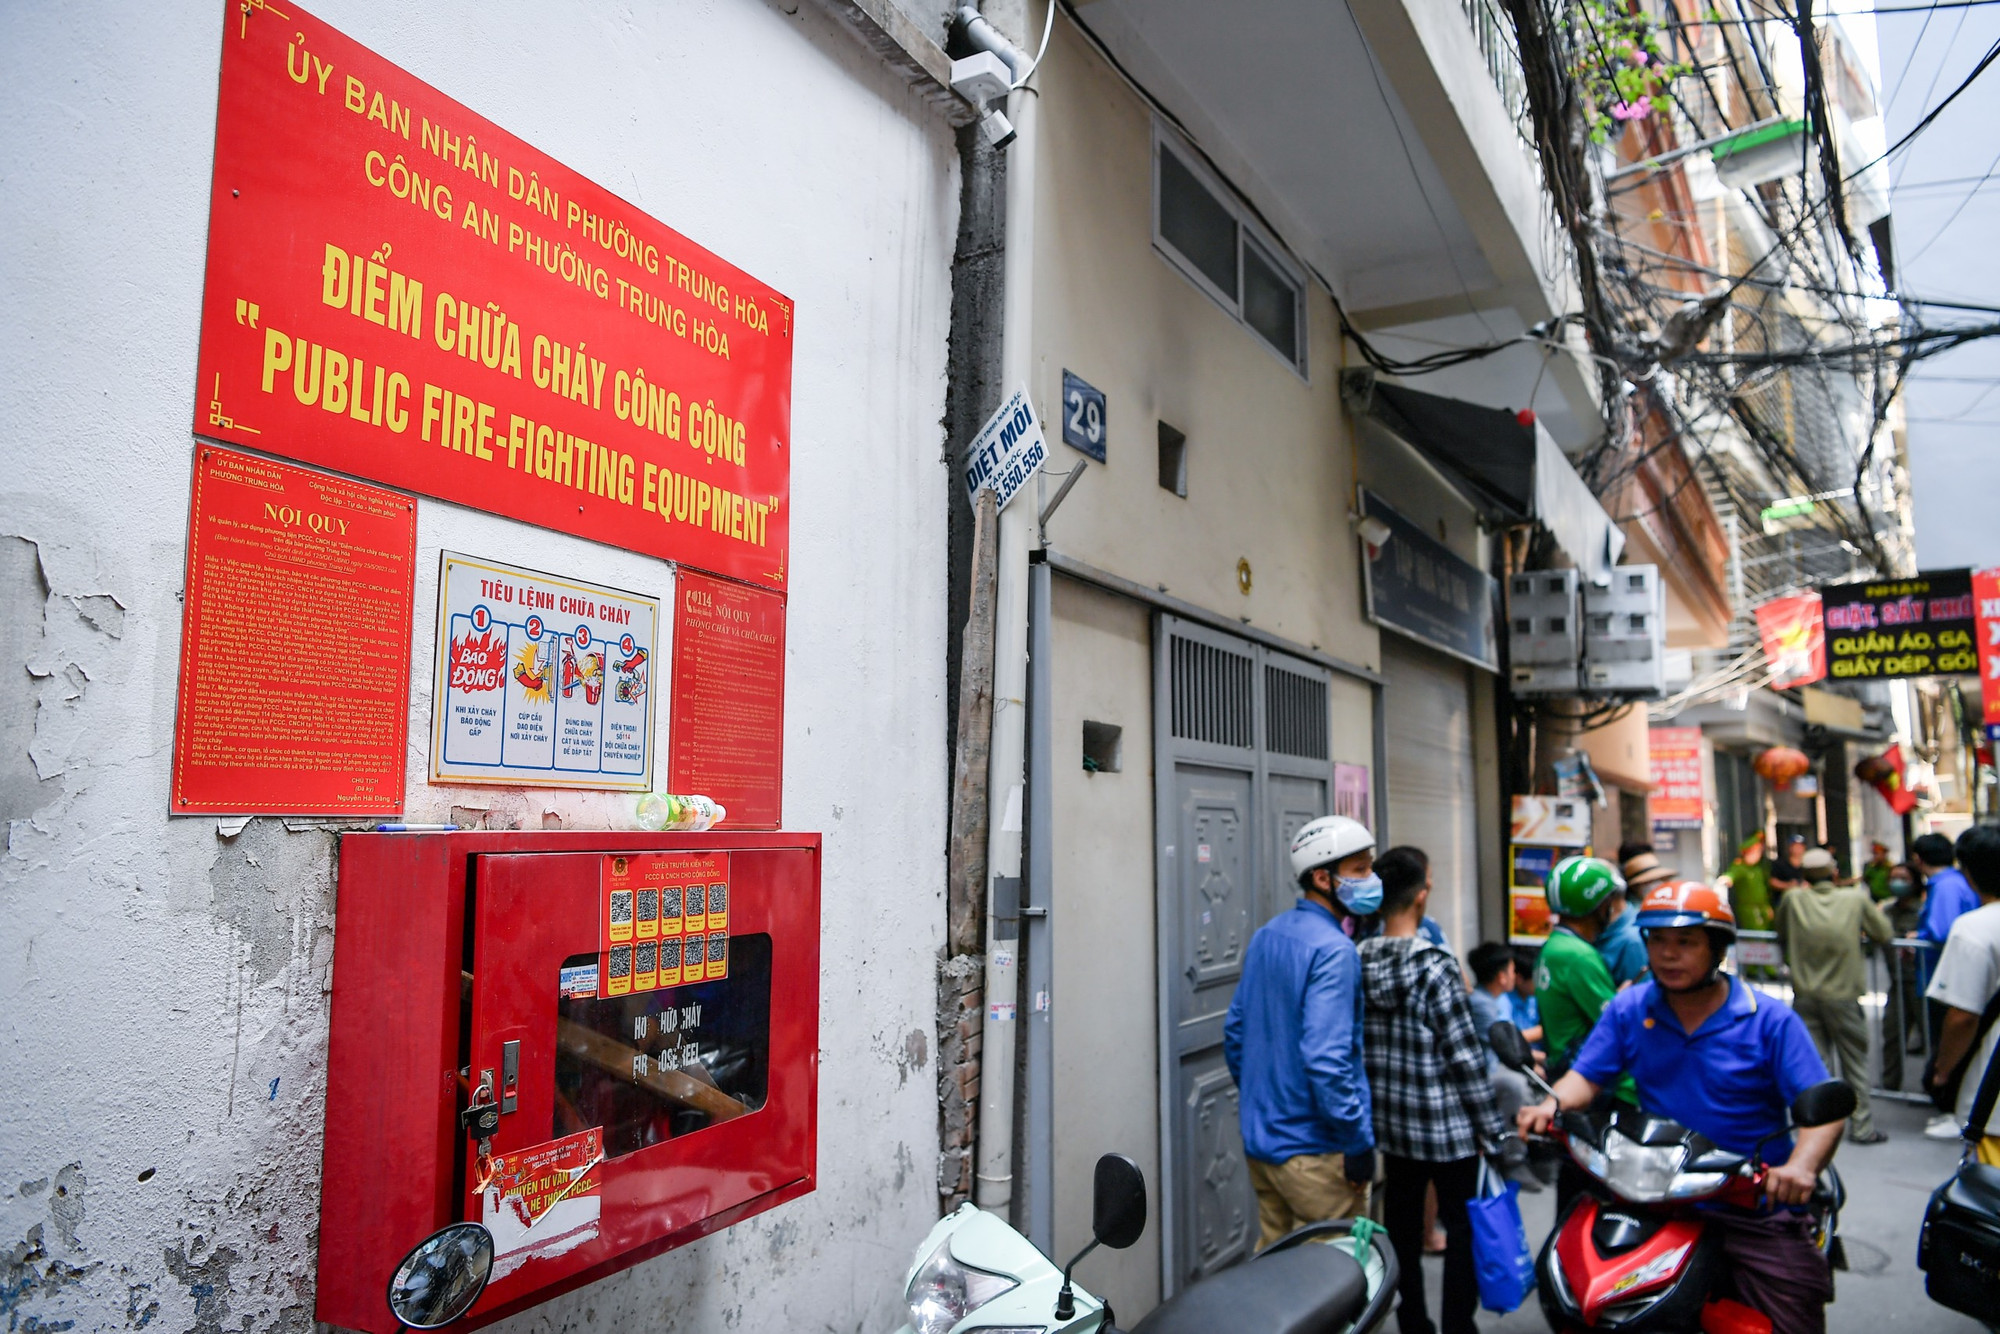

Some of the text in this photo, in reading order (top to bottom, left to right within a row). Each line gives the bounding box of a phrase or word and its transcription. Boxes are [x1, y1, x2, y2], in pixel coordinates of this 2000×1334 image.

[288, 32, 768, 336] ỦY BAN NHÂN DÂN PHƯỜNG TRUNG HÒA
[365, 151, 729, 360] CÔNG AN PHƯỜNG TRUNG HÒA
[323, 243, 745, 467] ĐIỂM CHỮA CHÁY CÔNG CỘNG
[1070, 390, 1100, 444] 29
[422, 383, 634, 505] FIRE-FIGHTING
[966, 440, 999, 494] DIỆT
[1000, 400, 1032, 454] MỐI
[210, 469, 284, 491] PHƯỜNG TRUNG HÒA
[218, 459, 281, 479] ỦY BAN NHÂN DÂN
[264, 503, 350, 535] NỘI QUY
[481, 580, 630, 625] TIÊU LỆNH CHỮA CHÁY
[697, 591, 711, 607] 114
[716, 604, 731, 619] NỘI
[733, 610, 751, 623] QUY
[474, 608, 634, 653] 1 2 3 4
[686, 617, 776, 644] PHÒNG CHÁY VÀ CHỮA CHÁY
[460, 649, 488, 666] BÁO
[452, 666, 496, 686] ĐỘNG
[656, 1005, 678, 1034] HỮA
